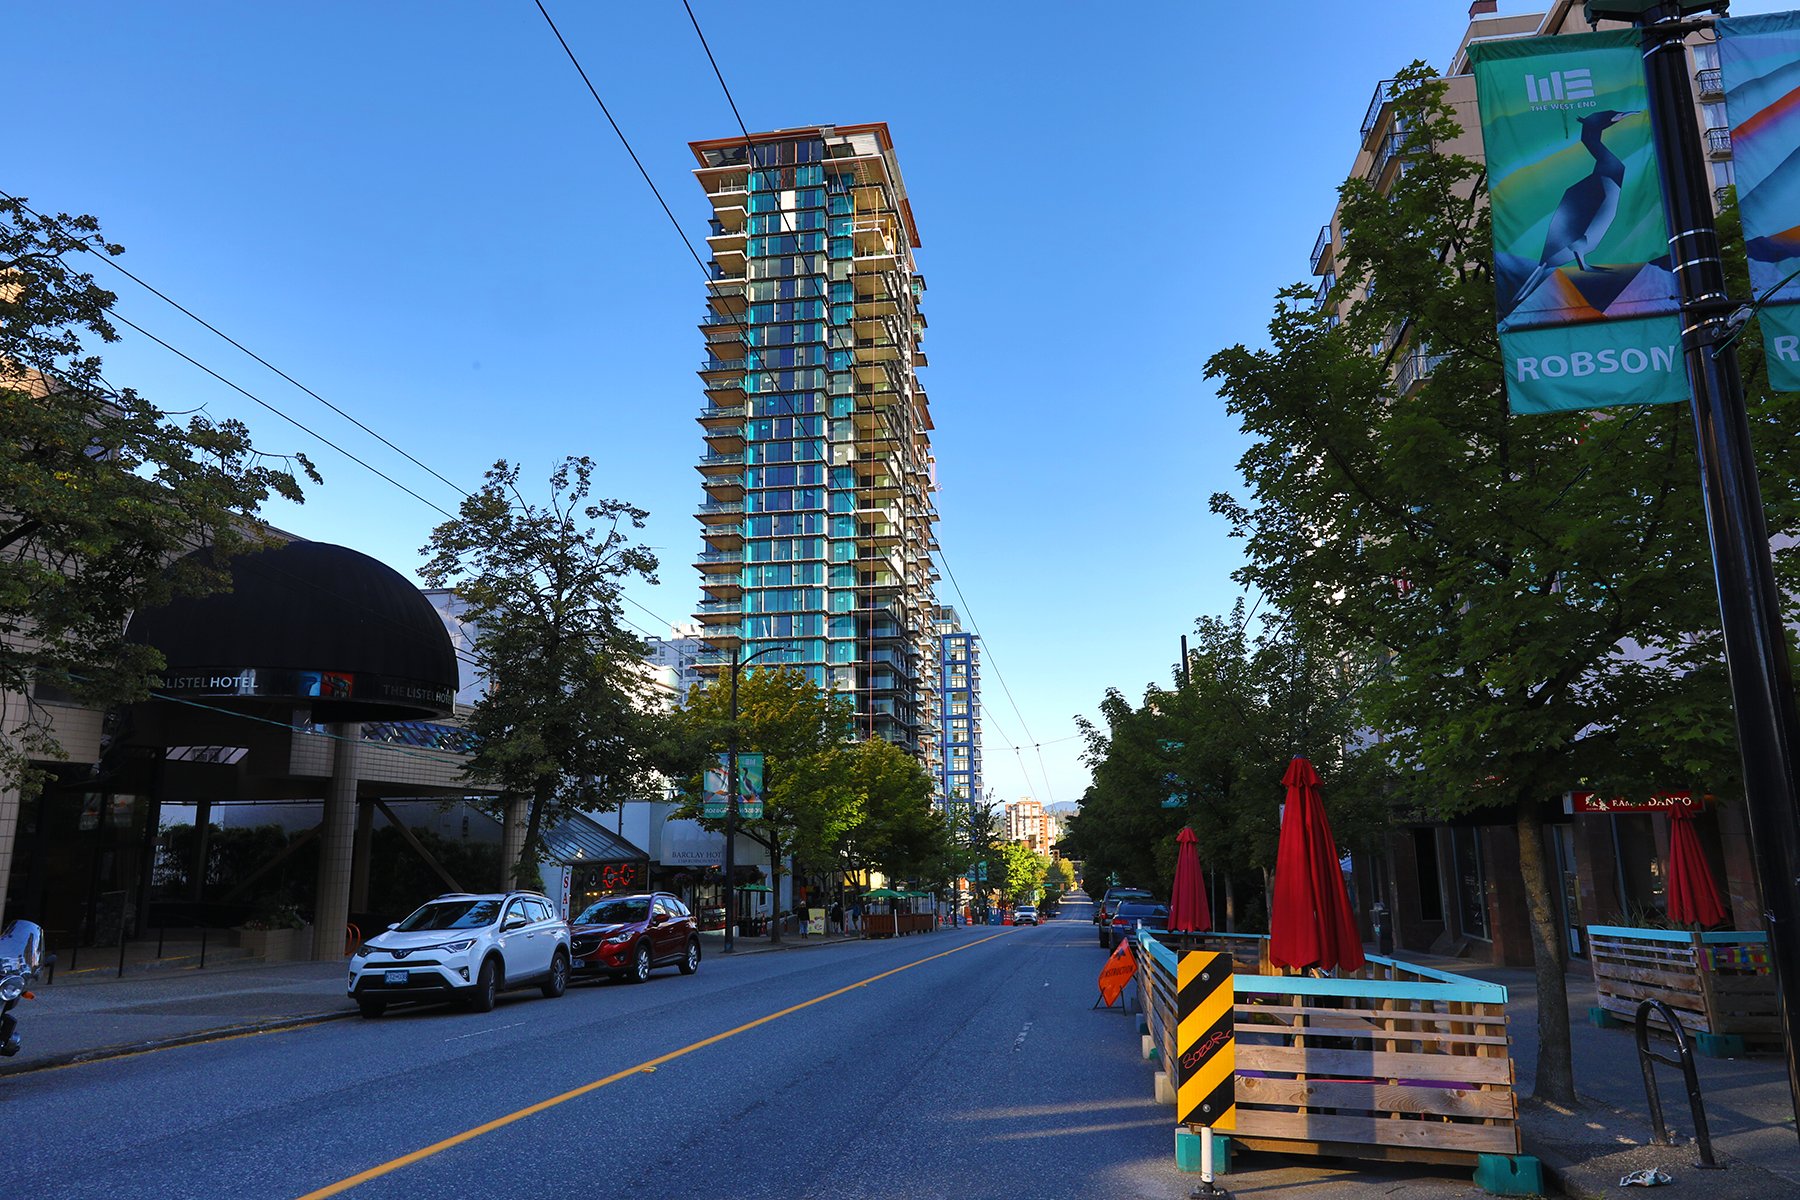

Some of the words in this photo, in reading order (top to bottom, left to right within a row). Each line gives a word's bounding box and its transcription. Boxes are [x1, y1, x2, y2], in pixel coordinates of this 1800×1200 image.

[1550, 103, 1575, 111] WEST
[1577, 101, 1597, 109] END
[1517, 345, 1675, 383] ROBSON
[166, 677, 208, 689] LISTEL
[209, 676, 259, 688] HOTEL
[383, 683, 405, 697] THE
[406, 687, 435, 702] LISTEL
